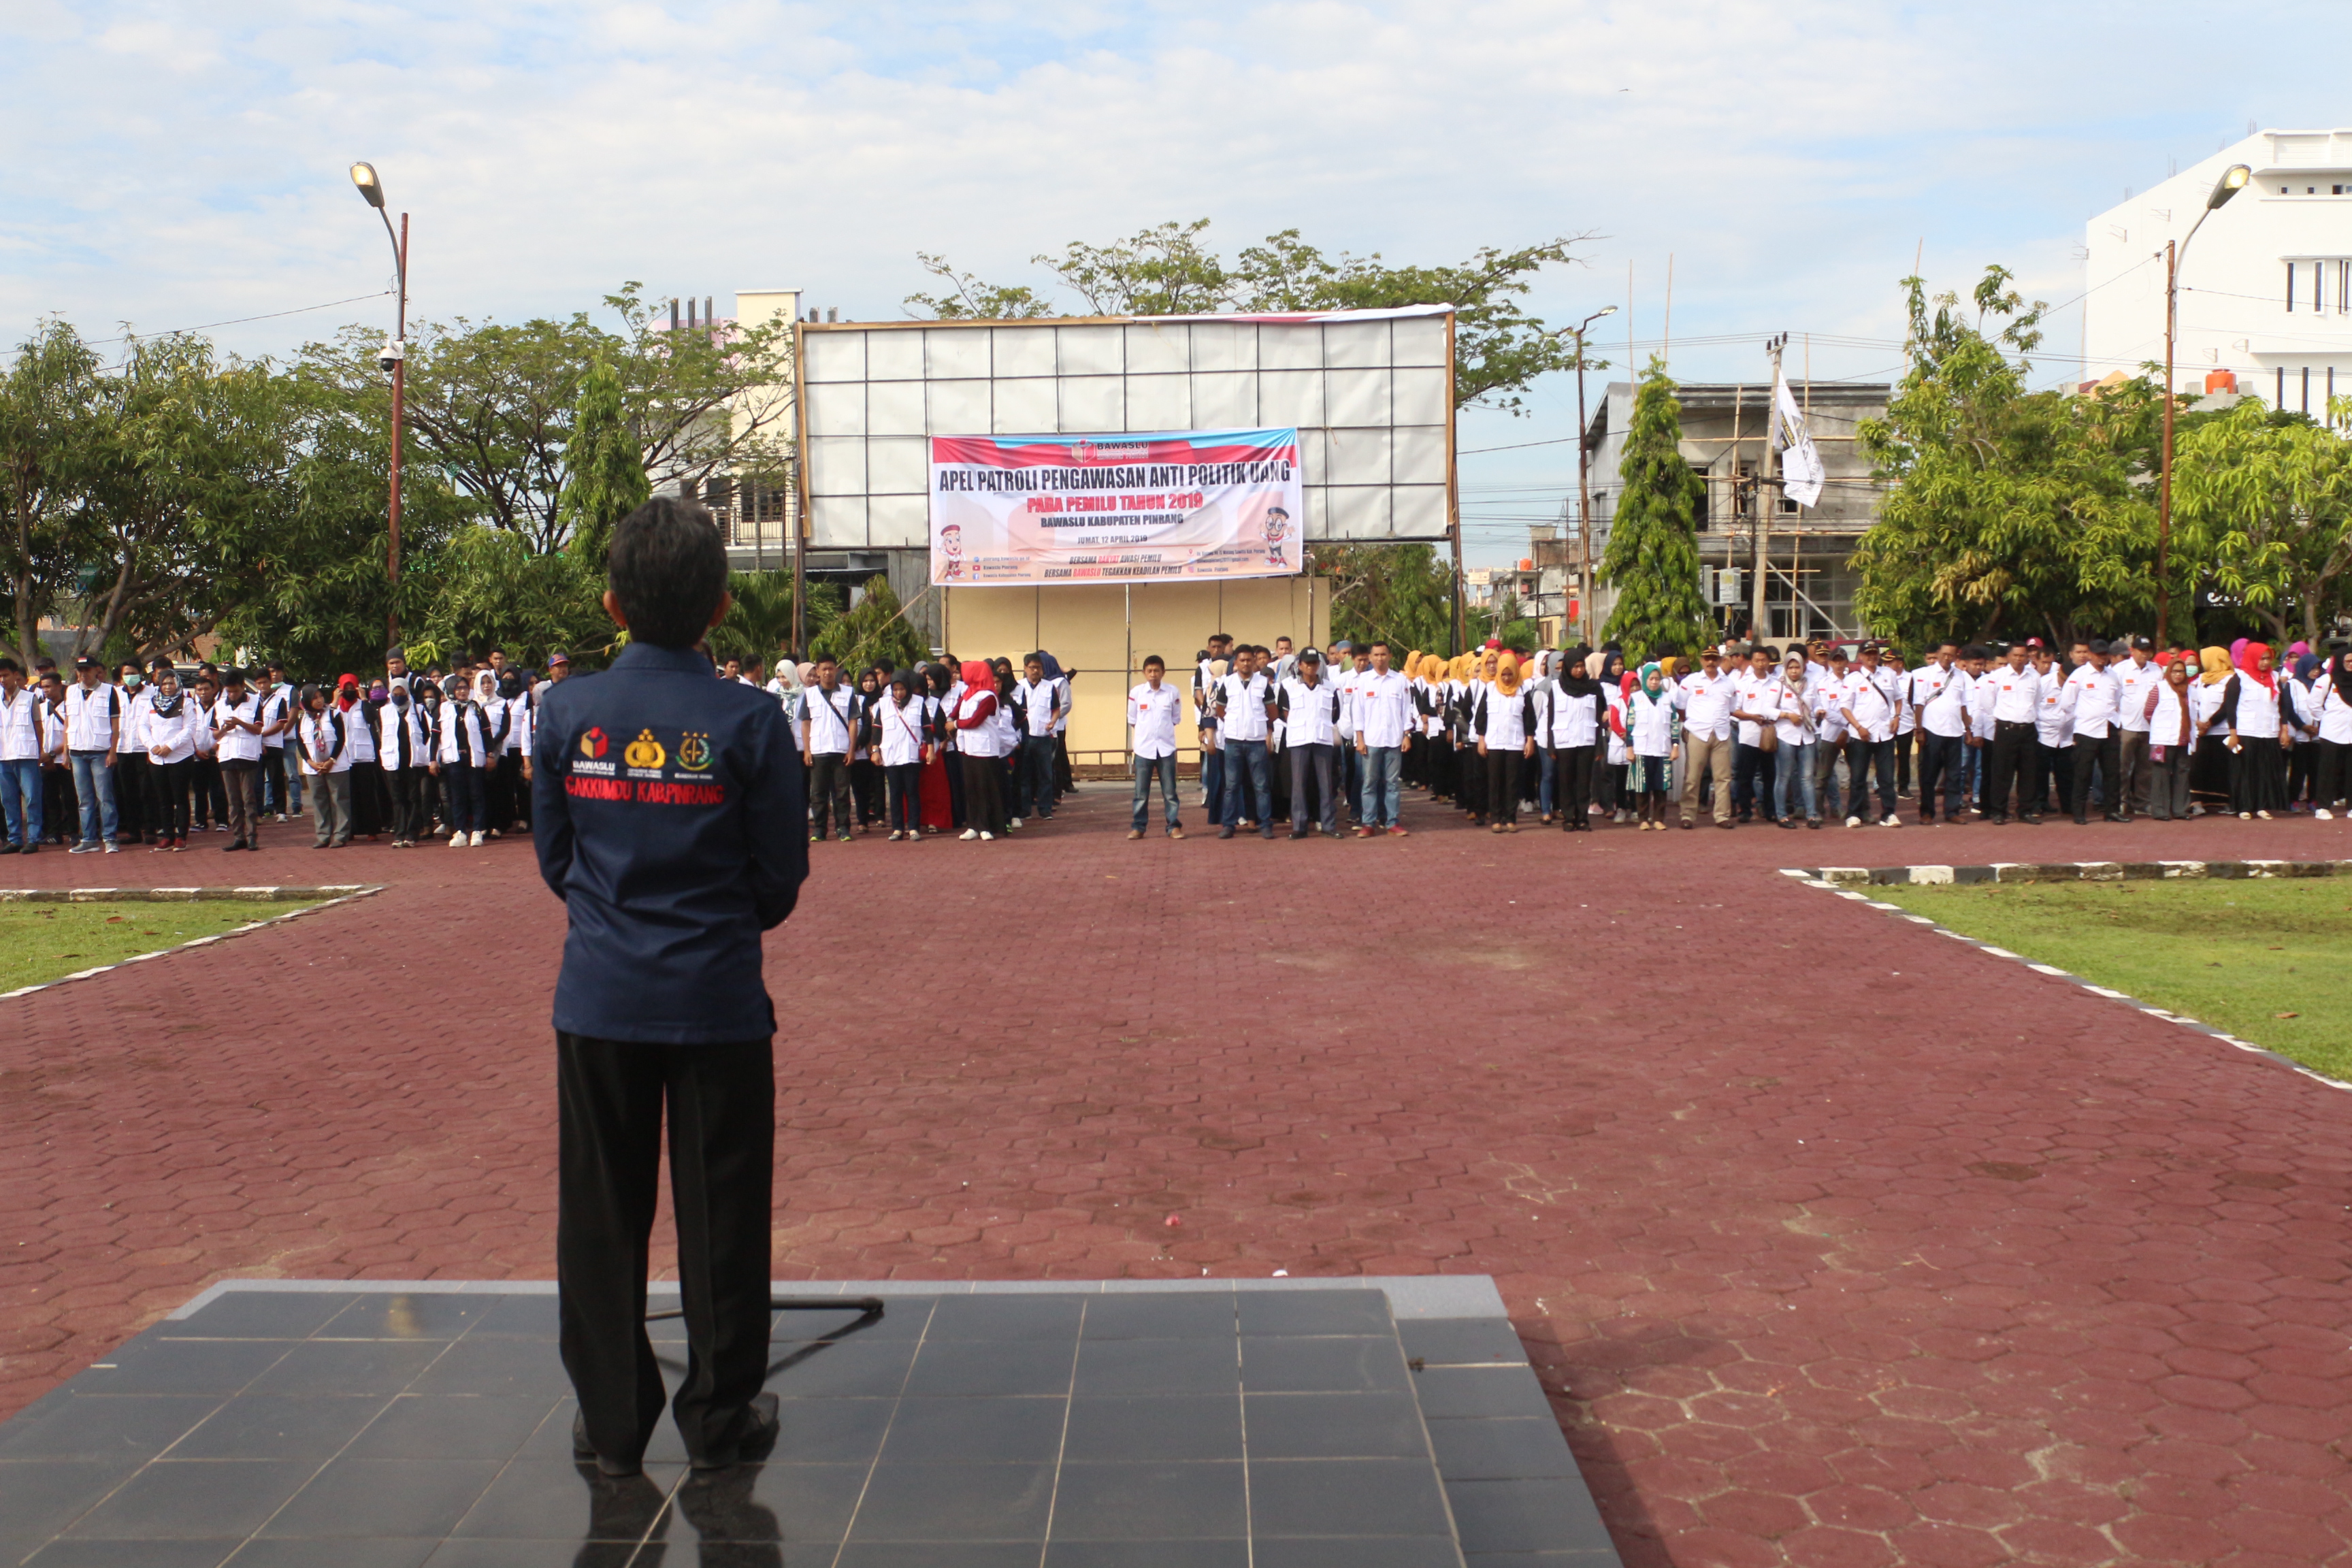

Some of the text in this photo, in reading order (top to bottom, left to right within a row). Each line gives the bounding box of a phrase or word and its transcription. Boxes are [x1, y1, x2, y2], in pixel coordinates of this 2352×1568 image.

[1097, 442, 1148, 450] BAWASLU
[939, 459, 1291, 491] APEL PATROLI PENGAWASAN ANTI POLITIK UANG
[1027, 492, 1203, 513] PADA PEMILU TAHUN 2019
[1041, 514, 1183, 527] BAWASLU KABUPATEN PINRANG
[1077, 536, 1100, 544] JUMAT,
[1110, 536, 1130, 544] APRIL
[1130, 535, 1147, 543] 2019
[1069, 553, 1162, 564] BERSAMA RAKYAT AWASI PEMILU
[1044, 566, 1182, 578] BERSAMA BAWASLU TEGAKKAN KEADILAN PEMILU
[572, 760, 616, 772] BAWASLU
